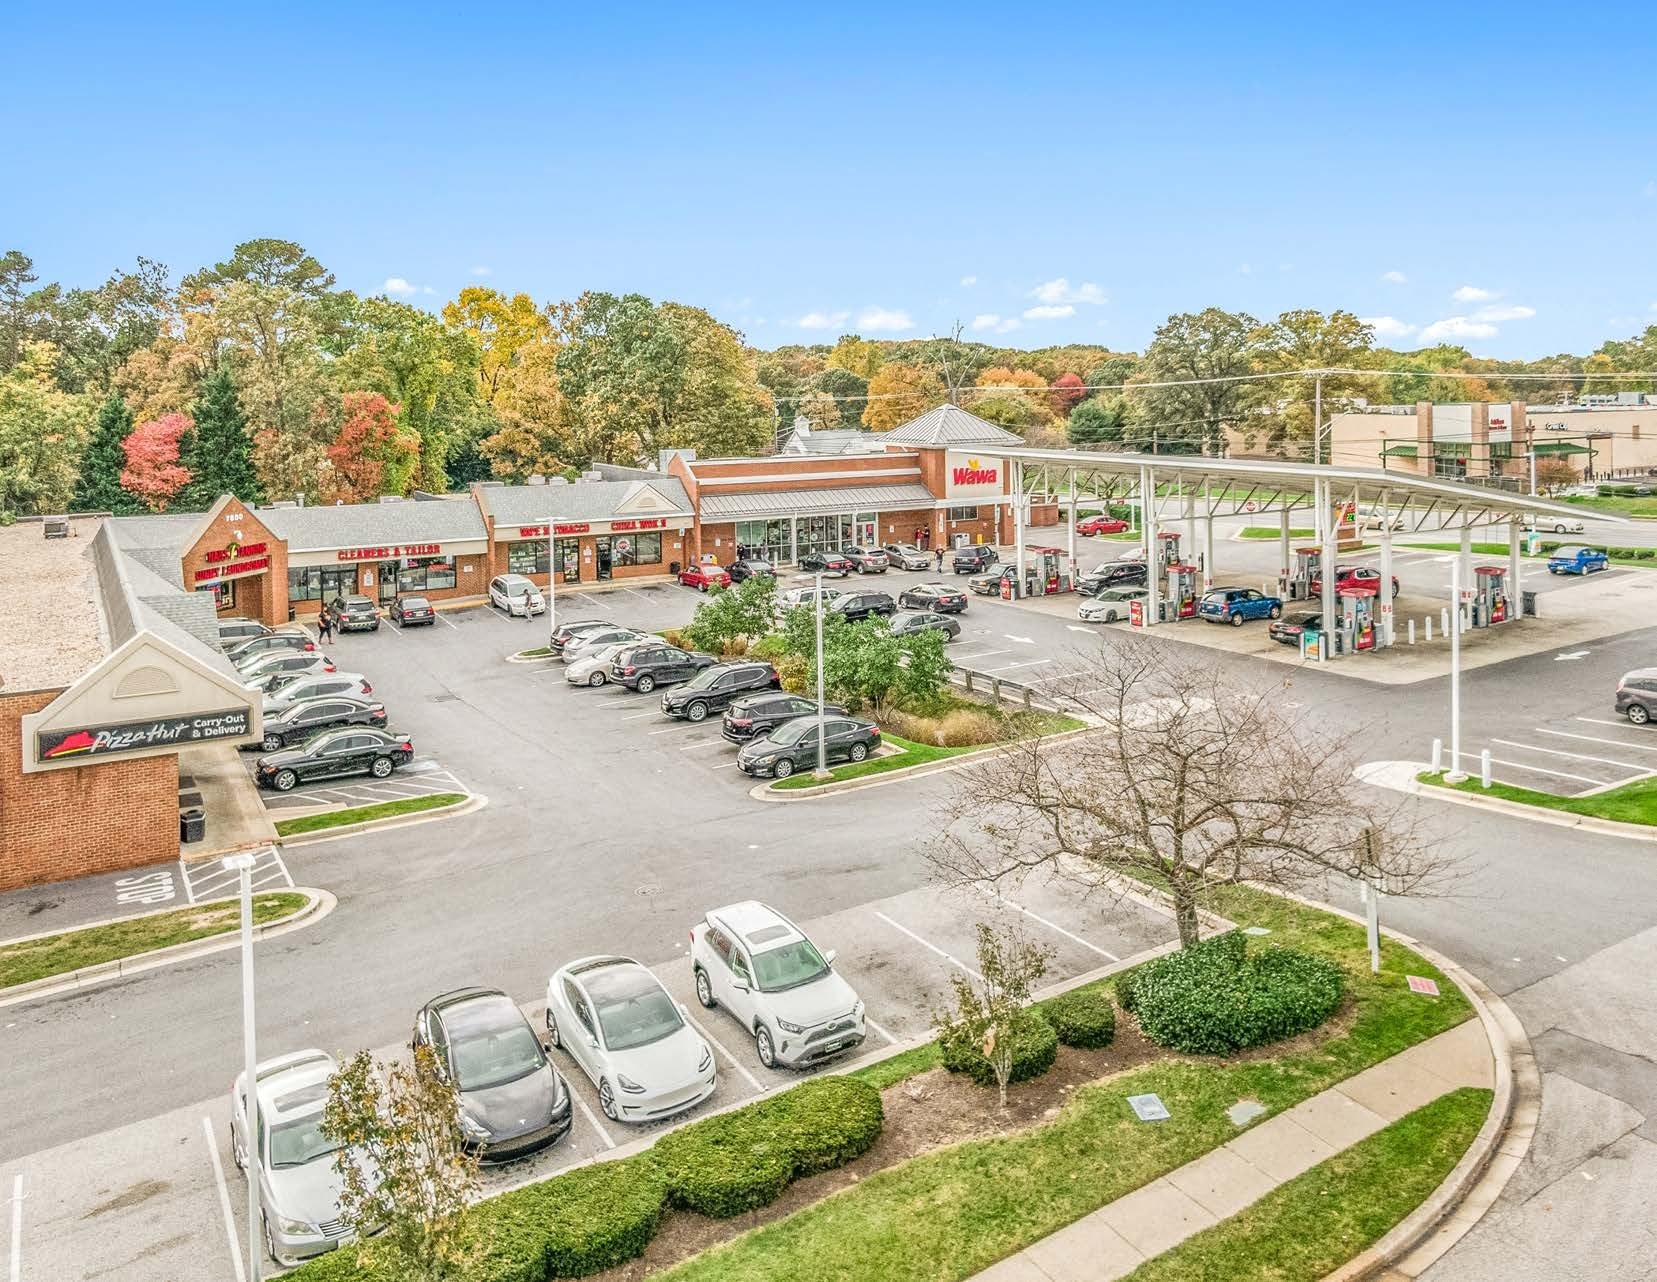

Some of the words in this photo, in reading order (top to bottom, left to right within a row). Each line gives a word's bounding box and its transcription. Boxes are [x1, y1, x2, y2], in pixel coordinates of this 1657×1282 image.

[953, 467, 997, 486] Wawa
[553, 523, 590, 534] TOBACCO
[611, 521, 636, 531] CHINA
[639, 519, 658, 529] WOK
[338, 547, 390, 561] CLEANERS
[393, 546, 401, 557] &
[404, 544, 441, 556] TAILOR
[193, 714, 245, 729] Carry-Out
[192, 729, 201, 738] &
[204, 724, 246, 738] Delivery
[115, 871, 176, 905] STOP
